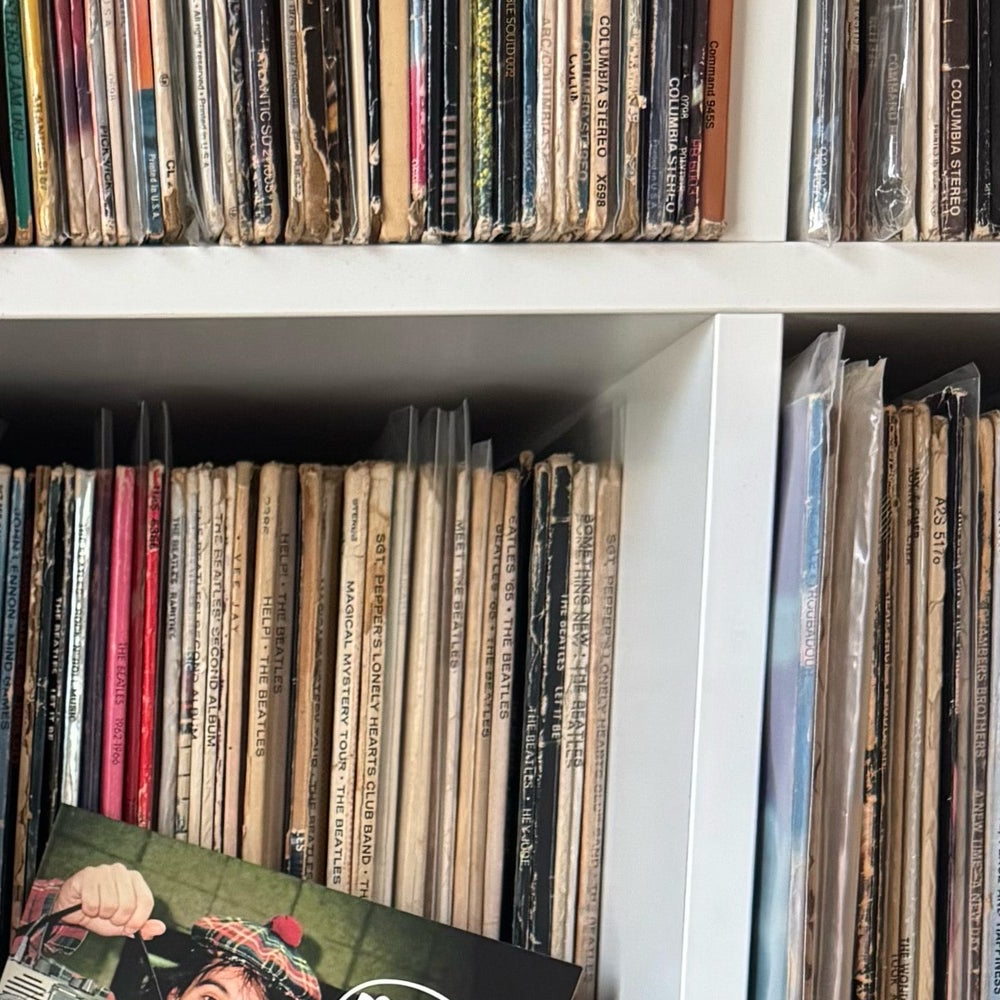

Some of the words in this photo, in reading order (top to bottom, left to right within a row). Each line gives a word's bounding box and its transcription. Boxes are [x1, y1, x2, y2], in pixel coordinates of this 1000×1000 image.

[193, 24, 203, 49] rights
[597, 15, 609, 94] COLUMBIA
[8, 72, 22, 106] JAM
[580, 40, 591, 118] COLUMBIA
[706, 40, 718, 96] Command
[261, 124, 271, 145] SD
[597, 99, 607, 157] STEREO
[669, 77, 680, 151] COLUMBIA
[705, 100, 716, 129] 945S
[950, 79, 962, 154] COLUMBIA
[596, 174, 607, 207] X698
[666, 156, 677, 212] STEREO
[950, 159, 962, 216] STEREO
[933, 497, 946, 525] A2S
[169, 539, 180, 585] BEATLES
[279, 533, 289, 577] HELP!
[580, 514, 594, 605] SOMETHING
[276, 593, 287, 622] THE
[373, 574, 385, 648] PEPPER'S
[505, 578, 515, 602] '65
[261, 596, 272, 639] HELP!
[343, 580, 355, 649] MAGICAL
[502, 617, 513, 647] THE
[580, 611, 591, 646] NEW
[601, 575, 614, 651] PEPPER'S
[3, 634, 16, 672] MIND
[117, 641, 127, 661] THE
[209, 627, 221, 690] SECOND
[259, 656, 269, 684] THE
[273, 627, 285, 694] BEATLES
[115, 665, 126, 706] BEATLES
[340, 654, 352, 725] MYSTERY
[370, 653, 382, 712] LONELY
[499, 653, 511, 719] BEATLES
[598, 653, 610, 712] LONELY
[67, 688, 78, 724] MUSIC
[207, 695, 218, 747] ALBUM
[255, 690, 269, 757] BEATLES
[975, 687, 986, 758] BROTHERS
[338, 729, 349, 771] TOUR
[367, 717, 379, 777] HEARTS
[551, 724, 562, 739] BE
[523, 734, 536, 789] BEATLES
[336, 785, 345, 814] THE
[364, 781, 376, 820] CLUB
[521, 808, 532, 826] HEY
[972, 800, 984, 831] NEW
[332, 819, 344, 884] BEATLES
[361, 825, 374, 865] BAND
[899, 937, 910, 958] THE
